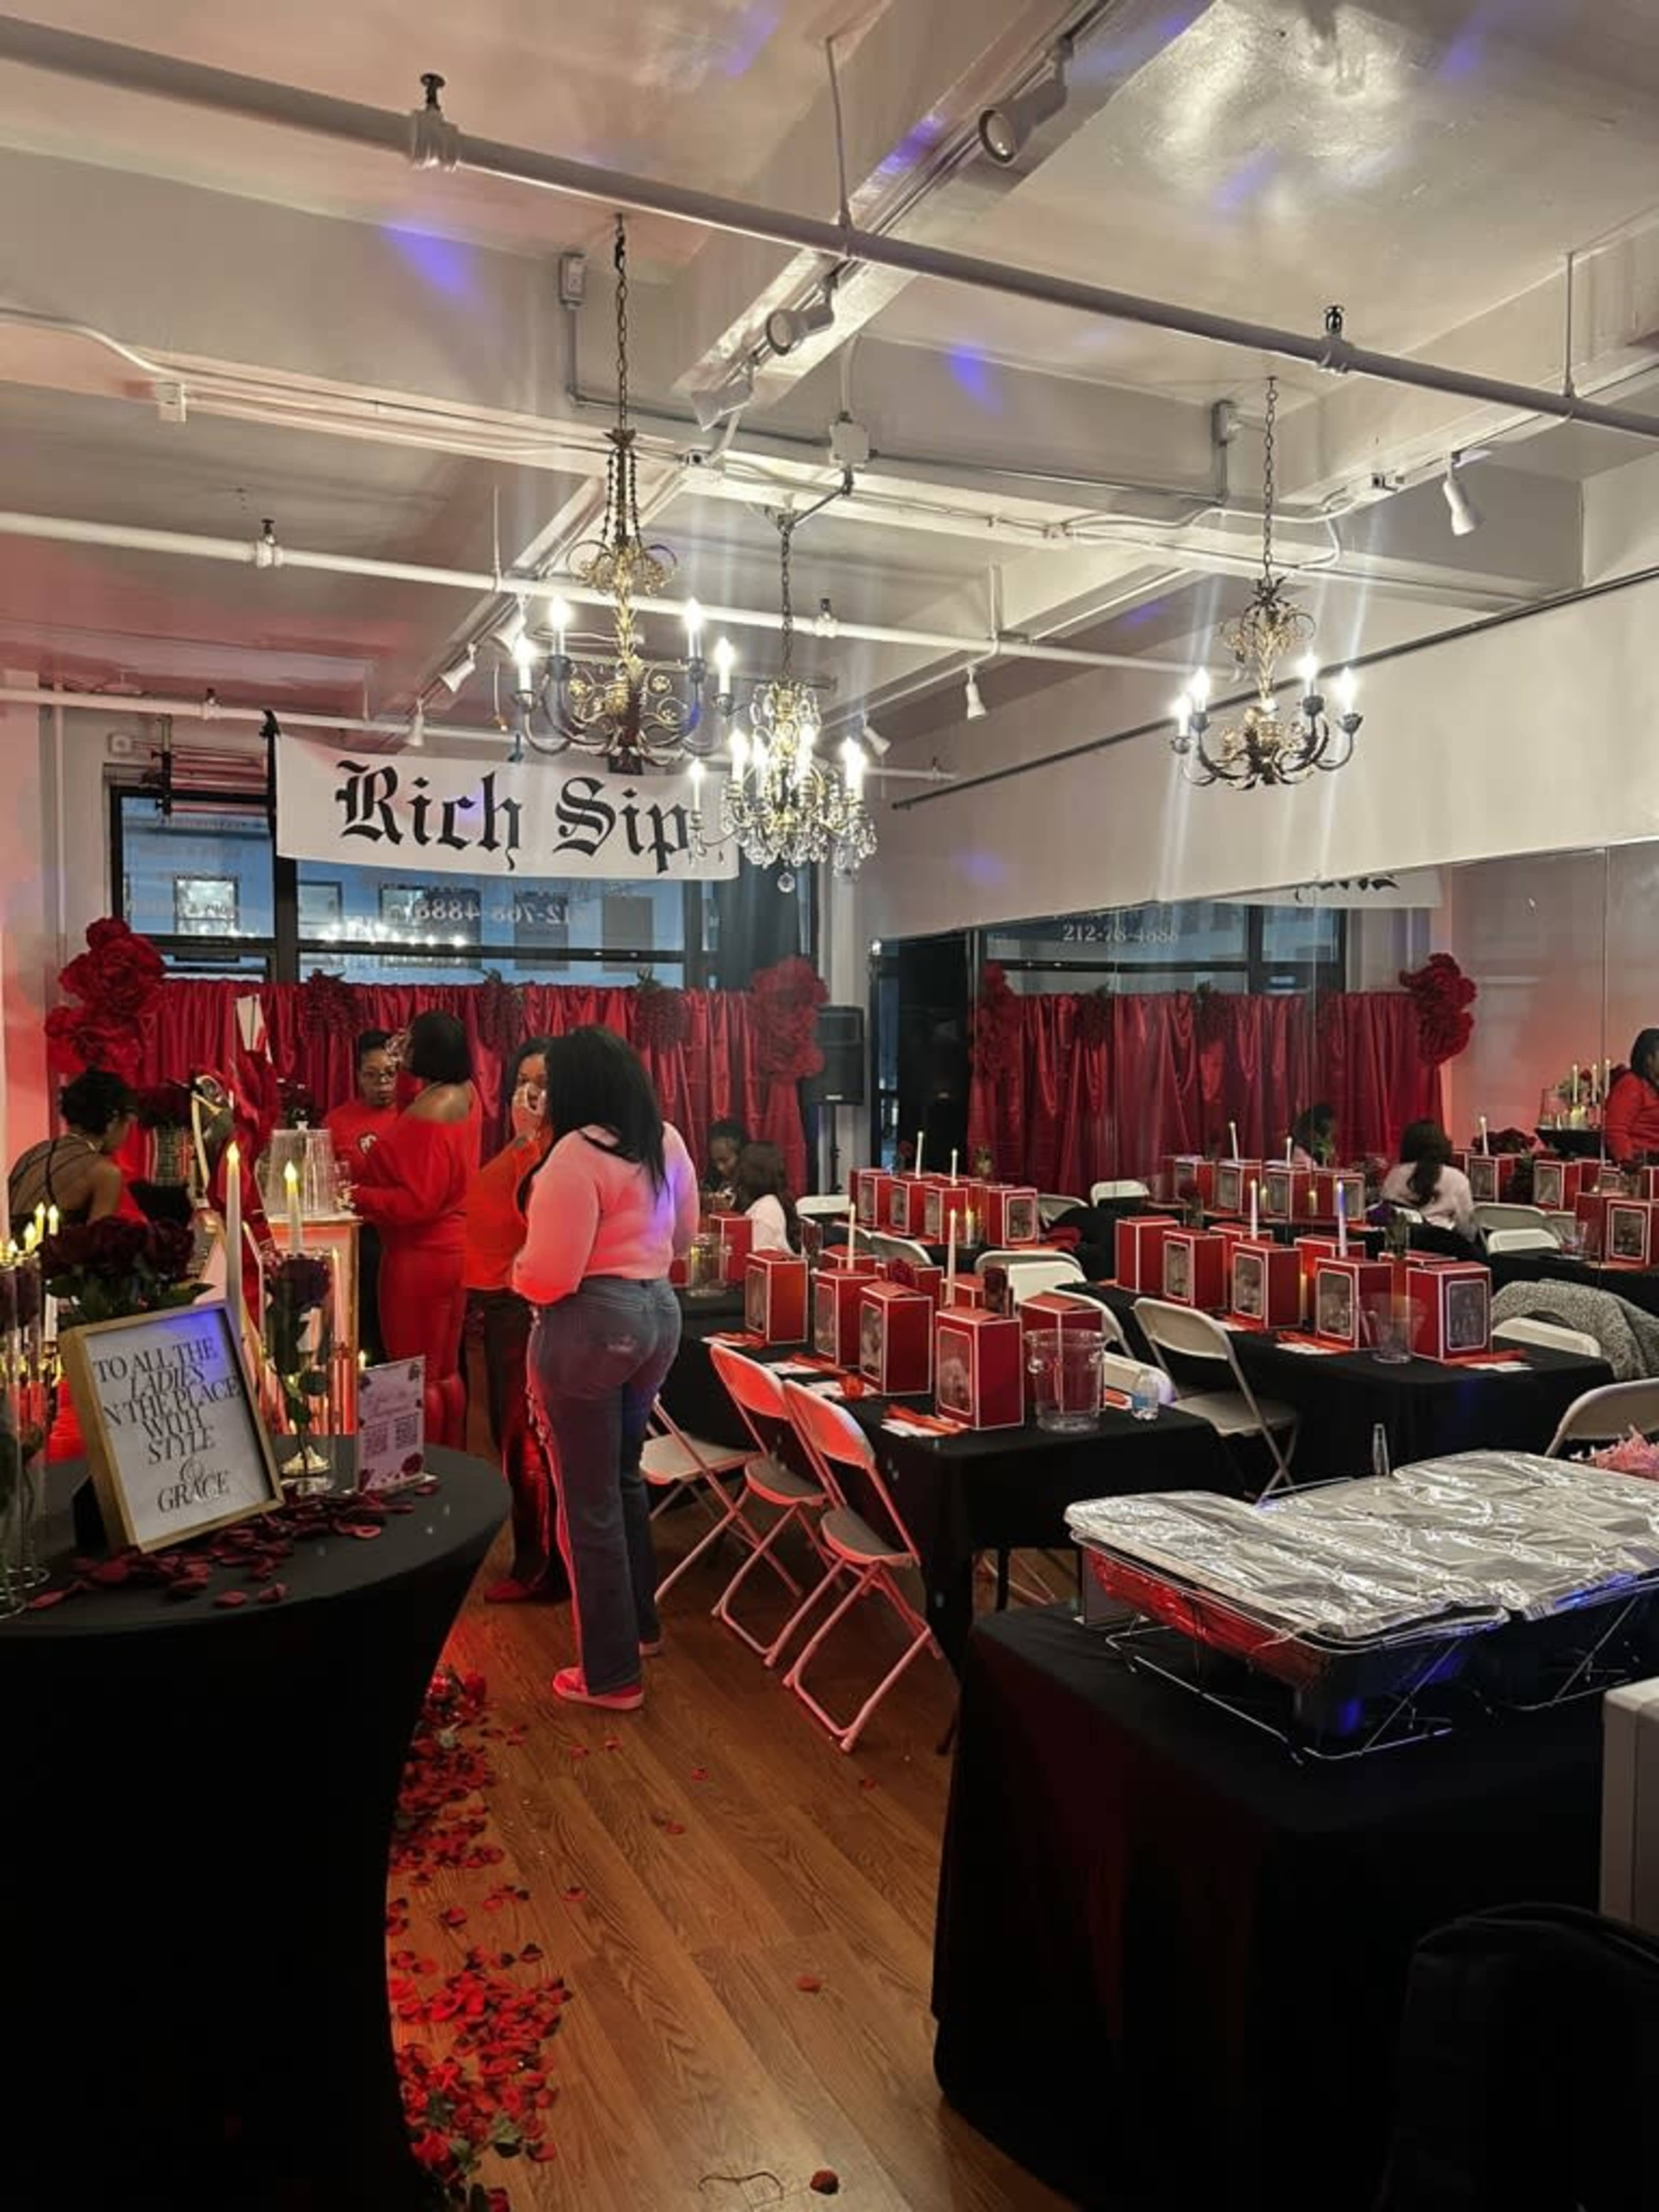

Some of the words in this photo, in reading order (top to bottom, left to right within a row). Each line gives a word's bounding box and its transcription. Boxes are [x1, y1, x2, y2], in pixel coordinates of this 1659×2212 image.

[334, 759, 522, 871] Rich
[553, 776, 690, 874] Sip
[93, 1356, 128, 1382] TO
[133, 1348, 173, 1373] ALL
[173, 1337, 219, 1362] THE
[124, 1394, 170, 1423] THE
[174, 1376, 241, 1413] PLACE
[131, 1362, 205, 1402] LADIES
[142, 1408, 203, 1437] WITH
[148, 1426, 215, 1465] STYLE
[157, 1470, 230, 1513] GRACE
